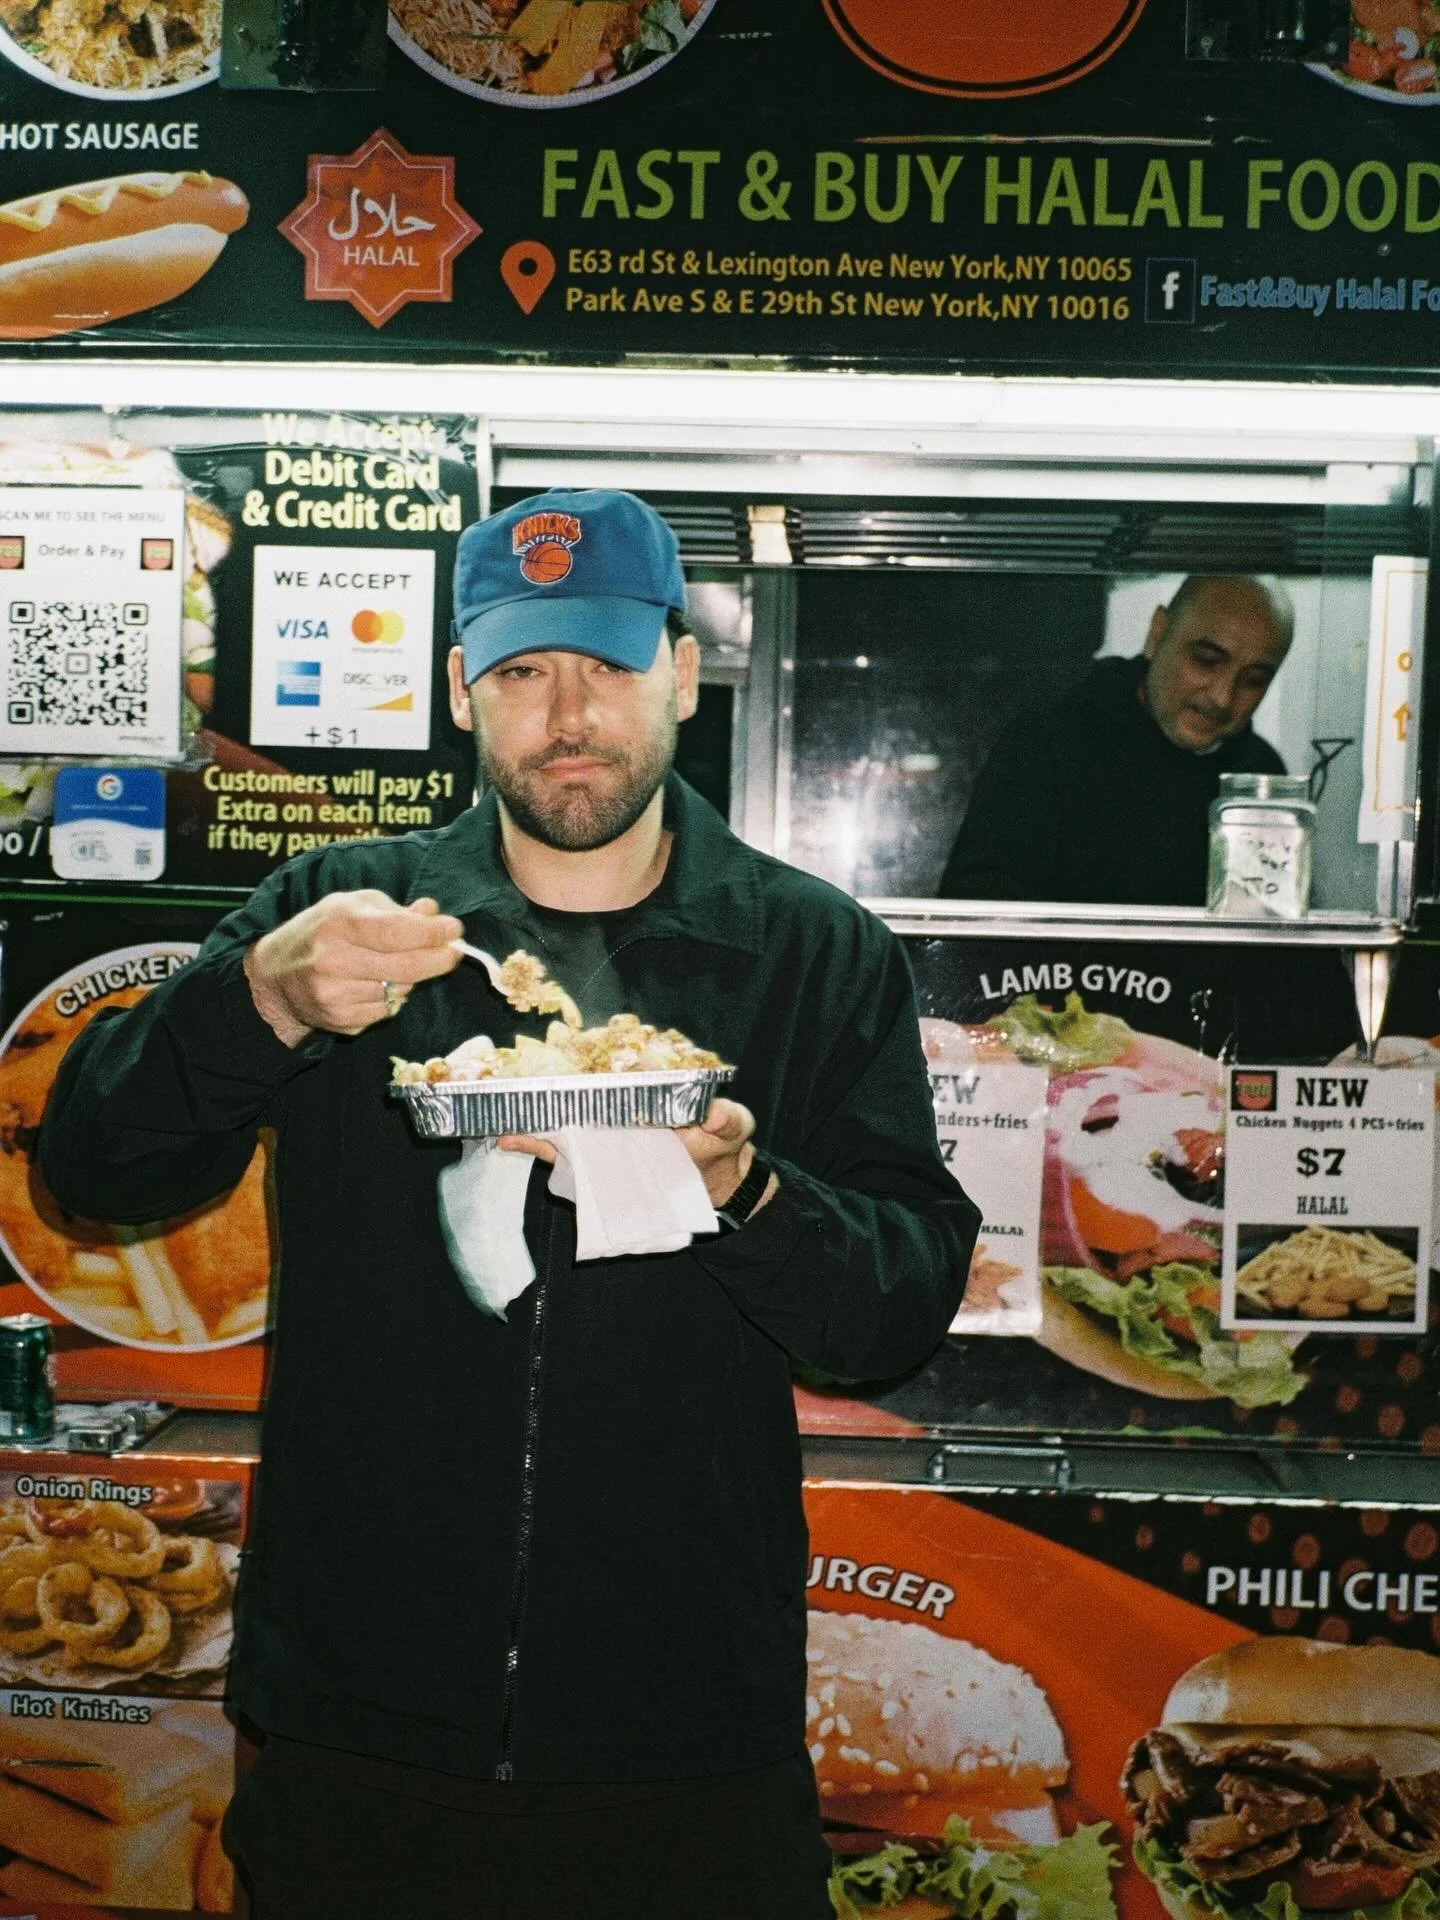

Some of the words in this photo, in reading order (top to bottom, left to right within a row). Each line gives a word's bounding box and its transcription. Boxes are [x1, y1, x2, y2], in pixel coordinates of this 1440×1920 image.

[0, 122, 60, 150] HOT
[64, 122, 200, 151] SAUSAGE
[542, 148, 721, 220] FAST
[738, 150, 792, 223] &
[814, 151, 964, 224] BUY
[984, 156, 1224, 228] HALAL
[1246, 158, 1440, 233] FOOD
[327, 186, 438, 241] حلال
[343, 245, 421, 267] HALAL
[568, 248, 612, 274] E63
[619, 248, 645, 274] rd
[651, 249, 676, 275] St
[681, 250, 700, 275] &
[706, 251, 830, 283] Lexington
[836, 253, 883, 279] Ave
[890, 254, 945, 279] New
[950, 254, 1050, 284] York,NY
[1057, 256, 1133, 283] 10065
[566, 287, 627, 313] Park
[632, 288, 684, 314] Ave
[690, 288, 706, 314] S
[711, 289, 733, 315] &
[740, 290, 755, 314] E
[761, 290, 823, 316] 29th
[829, 291, 857, 317] St
[864, 291, 924, 317] New
[930, 292, 1040, 322] York,NY
[1047, 294, 1131, 321] 10016
[1200, 275, 1332, 317] Fast&Buy
[1335, 277, 1407, 311] Halal
[262, 412, 314, 446] We
[264, 450, 359, 489] Debit
[363, 454, 441, 491] Card
[241, 489, 271, 527] &
[275, 489, 380, 530] Credit
[384, 494, 463, 532] Card
[513, 513, 580, 553] KNICKS
[38, 543, 80, 557] Order
[85, 544, 95, 557] &
[100, 543, 125, 560] Pay
[274, 569, 309, 588] WE
[318, 571, 412, 591] ACCEPT
[277, 618, 330, 640] VISA
[343, 672, 409, 687] DISCVER
[203, 765, 329, 795] Customers
[332, 769, 376, 796] will
[379, 776, 423, 803] pay
[426, 770, 454, 800] $1
[216, 795, 278, 821] Extra
[282, 803, 313, 823] on
[318, 799, 373, 824] each
[377, 801, 433, 826] item
[207, 824, 228, 850] if
[229, 825, 283, 858] they
[979, 963, 1074, 1000] LAMB
[1080, 963, 1172, 1004] GYRO
[1296, 1077, 1369, 1108] NEW
[1235, 1115, 1288, 1129] Chicken
[1292, 1116, 1344, 1133] Nuggets
[1296, 1146, 1347, 1179] $7
[1296, 1195, 1349, 1216] HALAL
[16, 1475, 85, 1498] Onion
[90, 1478, 152, 1507] Rings
[1205, 1565, 1331, 1610] PHILI
[1342, 1570, 1439, 1613] CHE
[12, 1695, 55, 1717] Hot
[63, 1698, 151, 1723] Knishes
